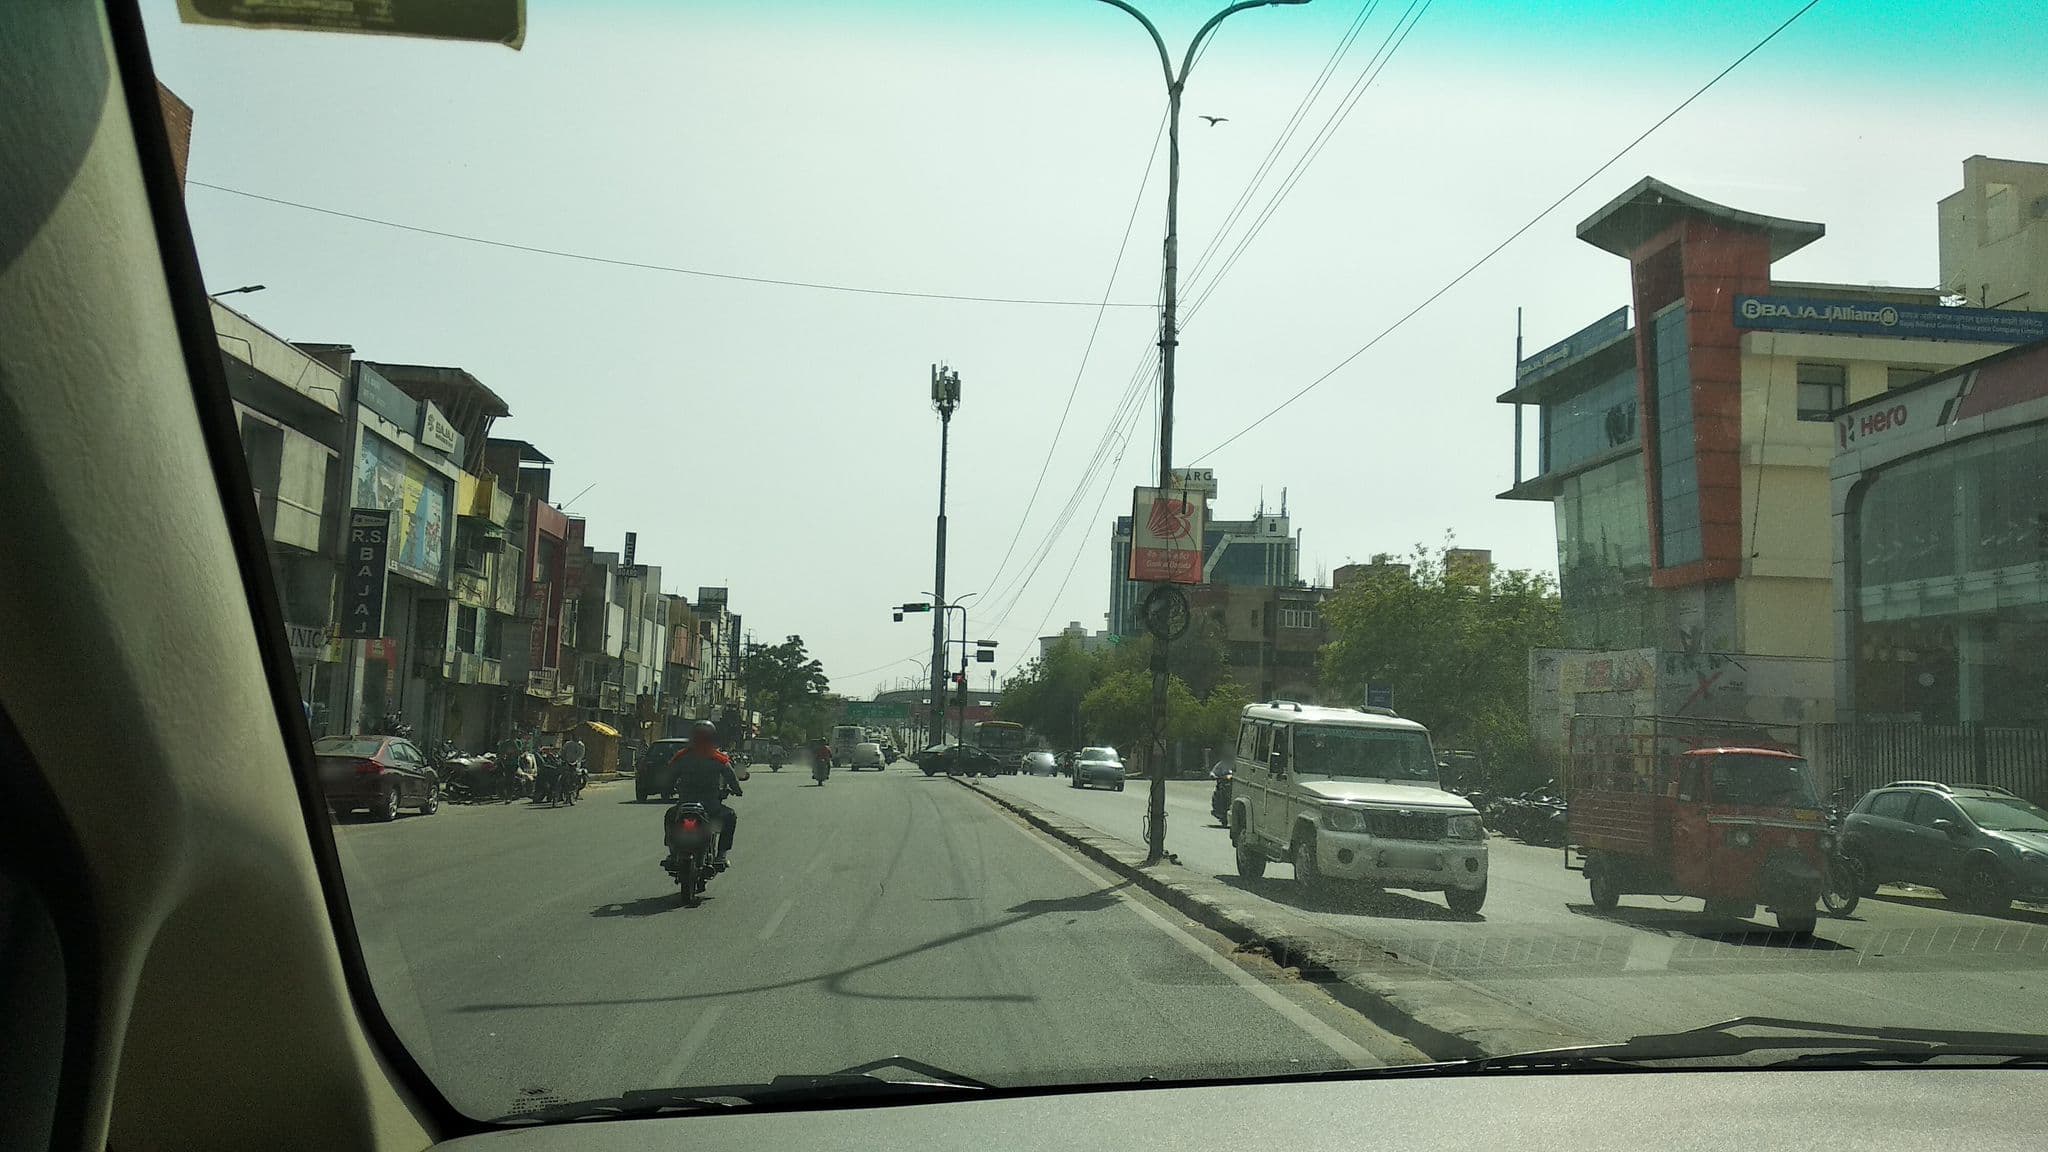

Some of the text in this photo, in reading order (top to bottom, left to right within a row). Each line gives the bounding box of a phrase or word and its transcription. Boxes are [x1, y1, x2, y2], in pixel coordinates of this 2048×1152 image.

[1833, 305, 1880, 321] Allianz
[1185, 471, 1212, 481] ARG
[352, 529, 385, 543] R.S.
[625, 533, 634, 567] LED
[355, 547, 375, 633] BAJAJ
